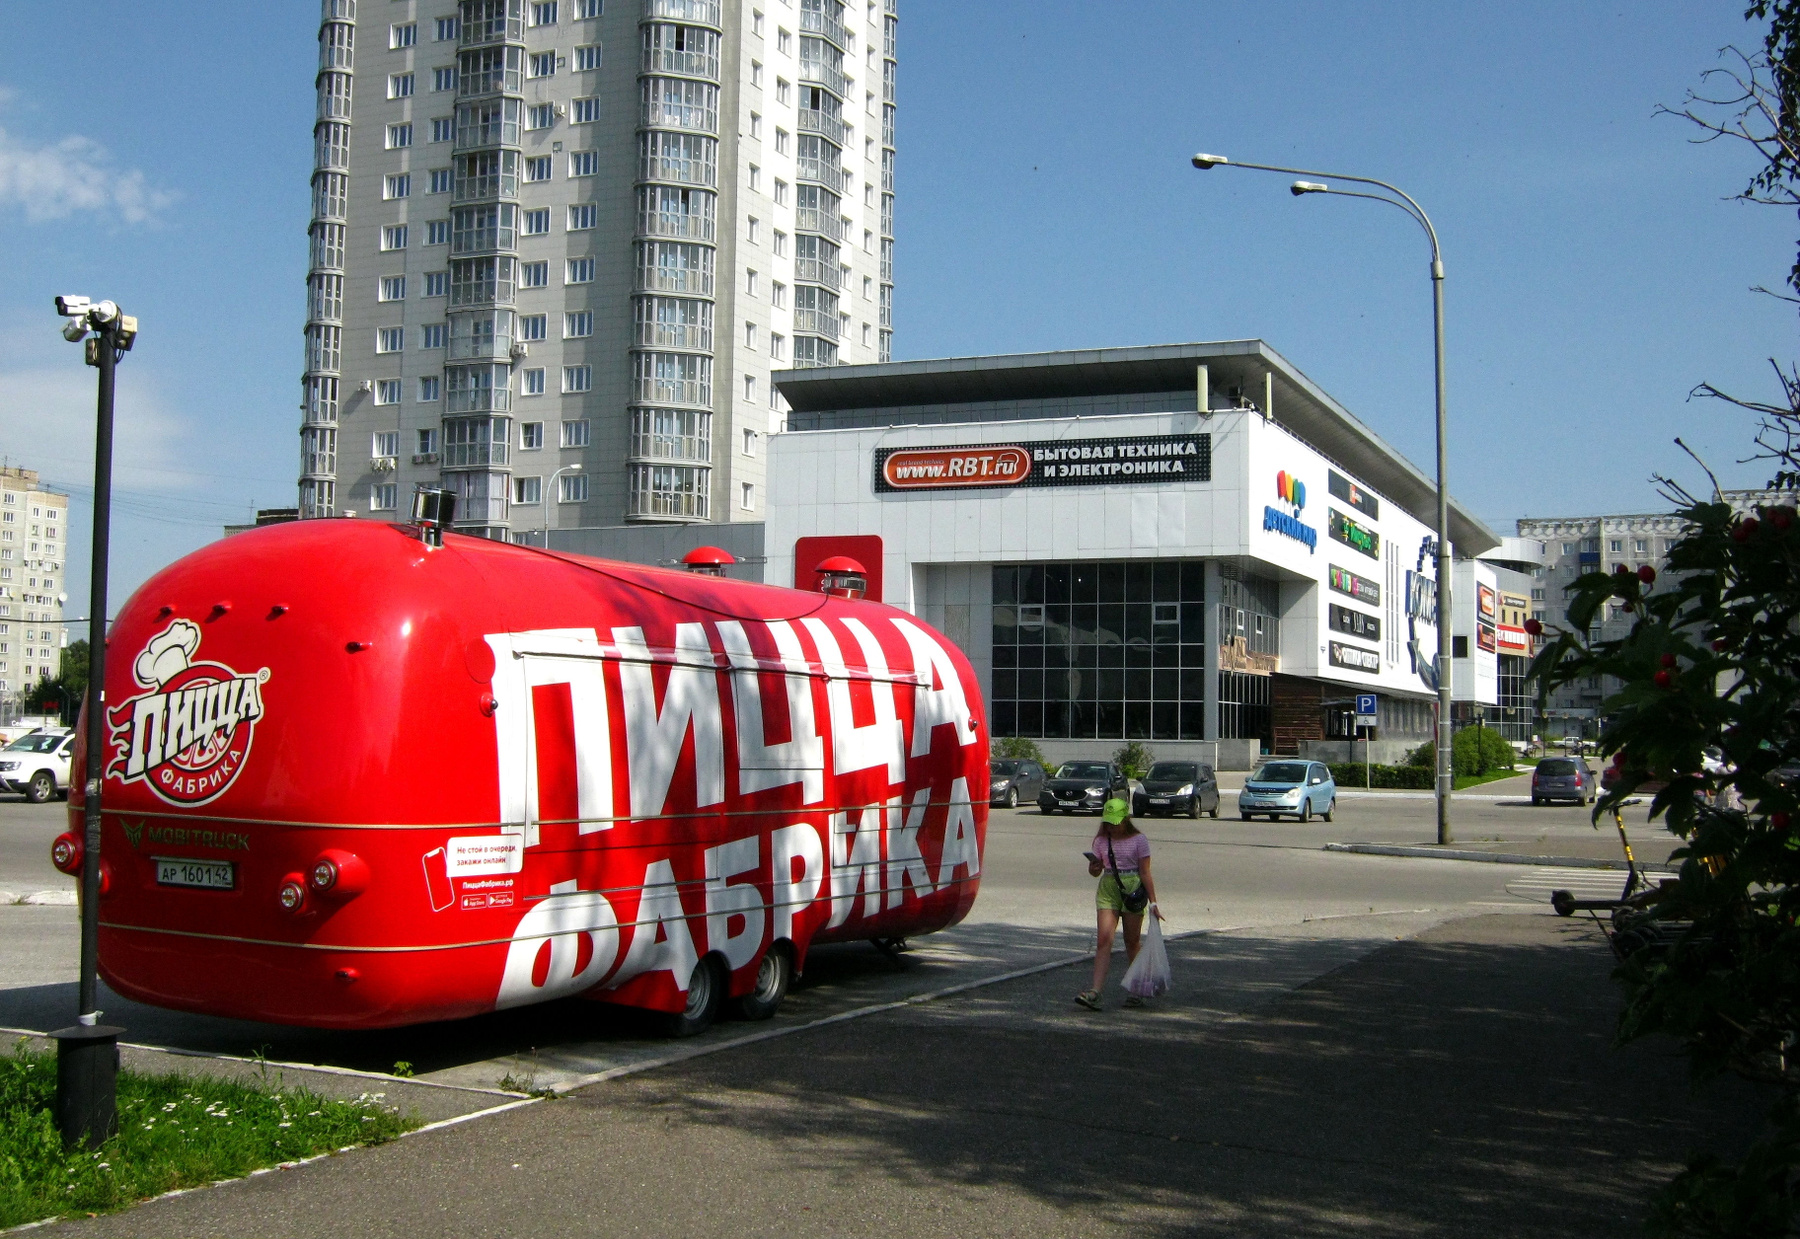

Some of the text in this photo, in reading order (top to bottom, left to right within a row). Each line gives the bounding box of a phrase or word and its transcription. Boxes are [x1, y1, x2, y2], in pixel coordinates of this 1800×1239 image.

[1033, 442, 1198, 462] БЫТОВАЯ ТЕХНИКА
[896, 455, 1018, 479] www.RBT.ru
[1043, 460, 1185, 477] И ЭЛЕКТРОНИКА
[1361, 697, 1372, 712] P
[126, 677, 261, 778] ПИЦЦА
[484, 618, 977, 848] ПИЦЦА
[161, 749, 241, 794] ФАБРИКА
[148, 826, 250, 851] MOBITRUCK
[467, 845, 483, 853] стой
[483, 856, 506, 864] онлайн
[495, 777, 979, 1010] ФАБРИКА
